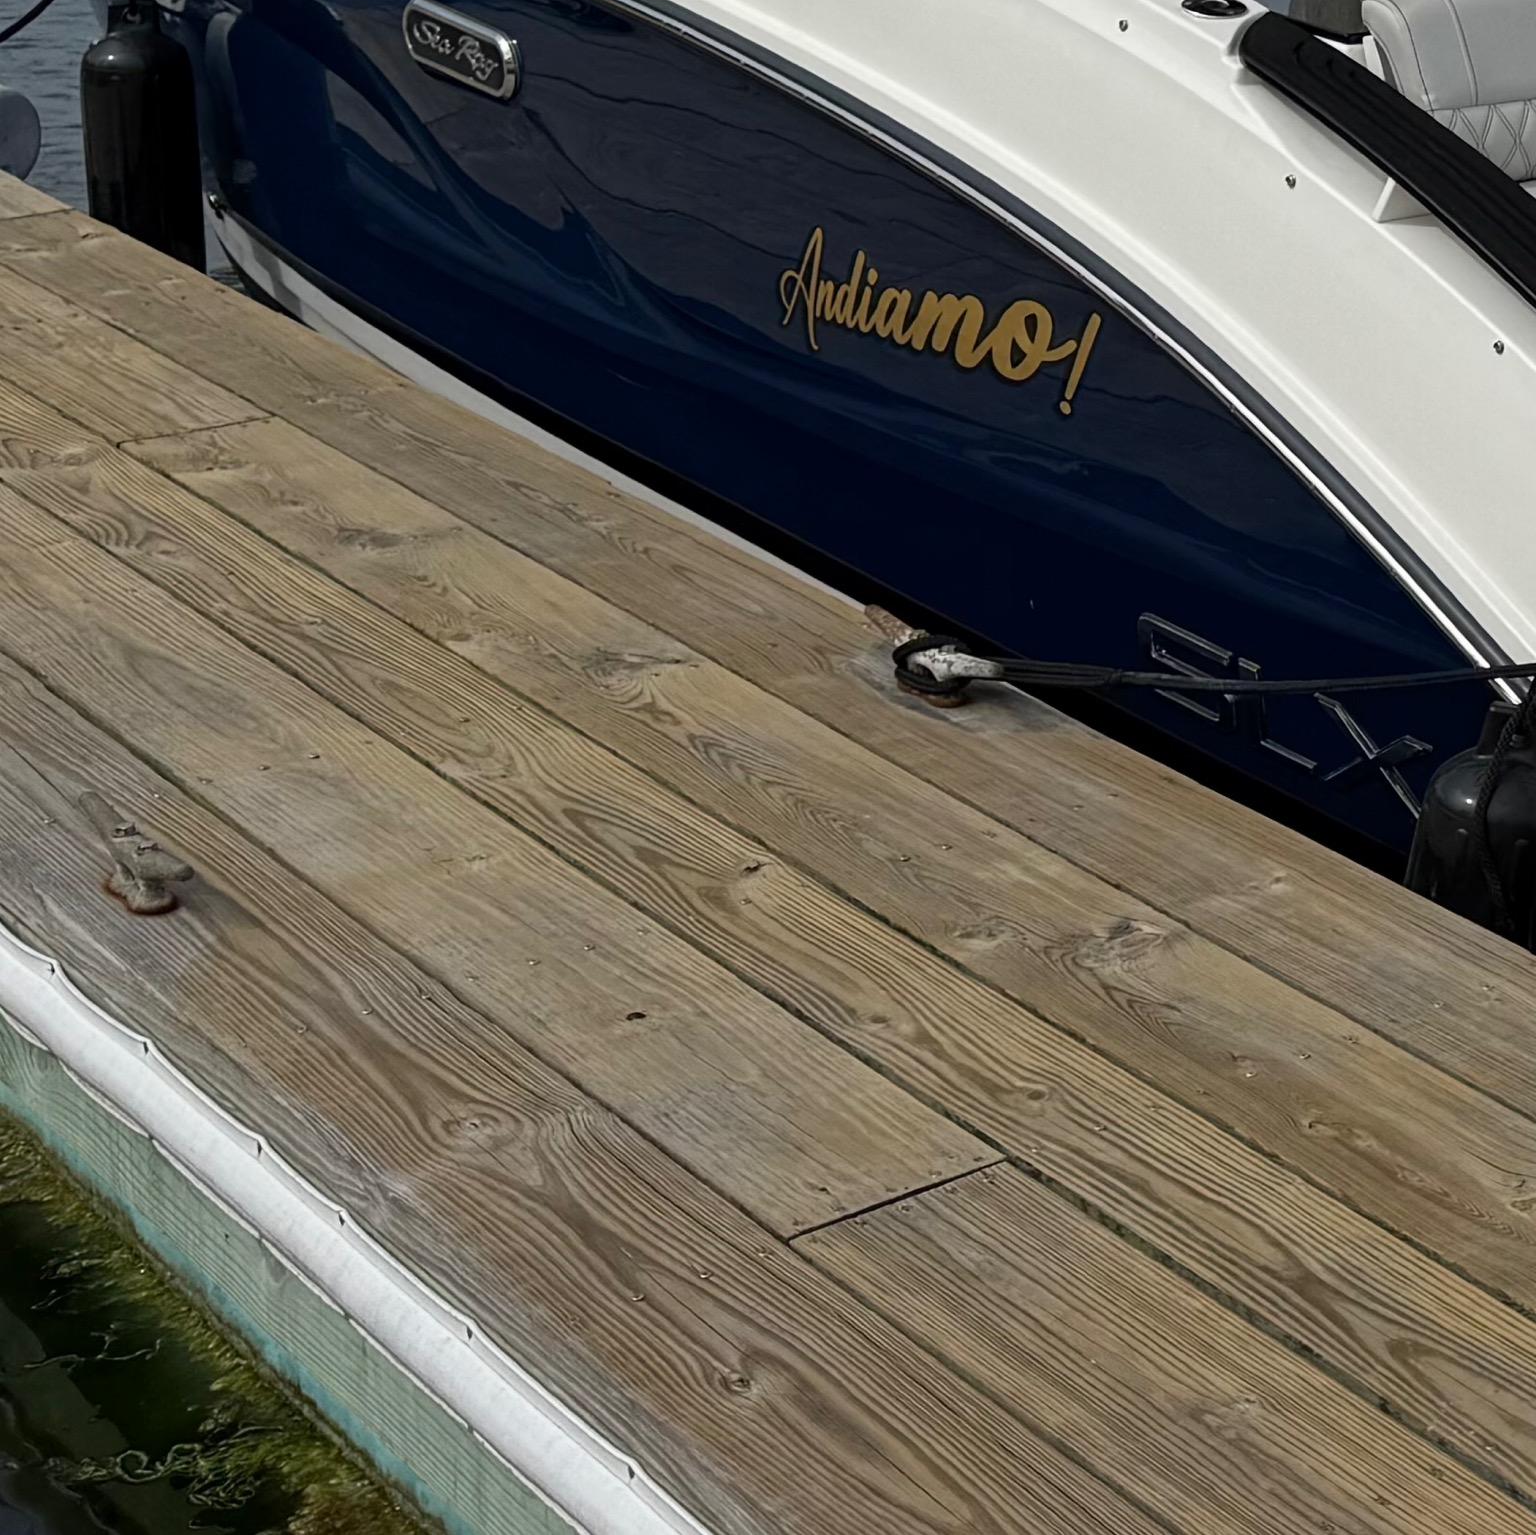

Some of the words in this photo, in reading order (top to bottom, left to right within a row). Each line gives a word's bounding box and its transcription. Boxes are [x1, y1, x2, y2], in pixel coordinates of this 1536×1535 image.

[413, 20, 455, 55] Sea
[454, 35, 499, 81] Ray
[779, 227, 1101, 415] Andiamo!
